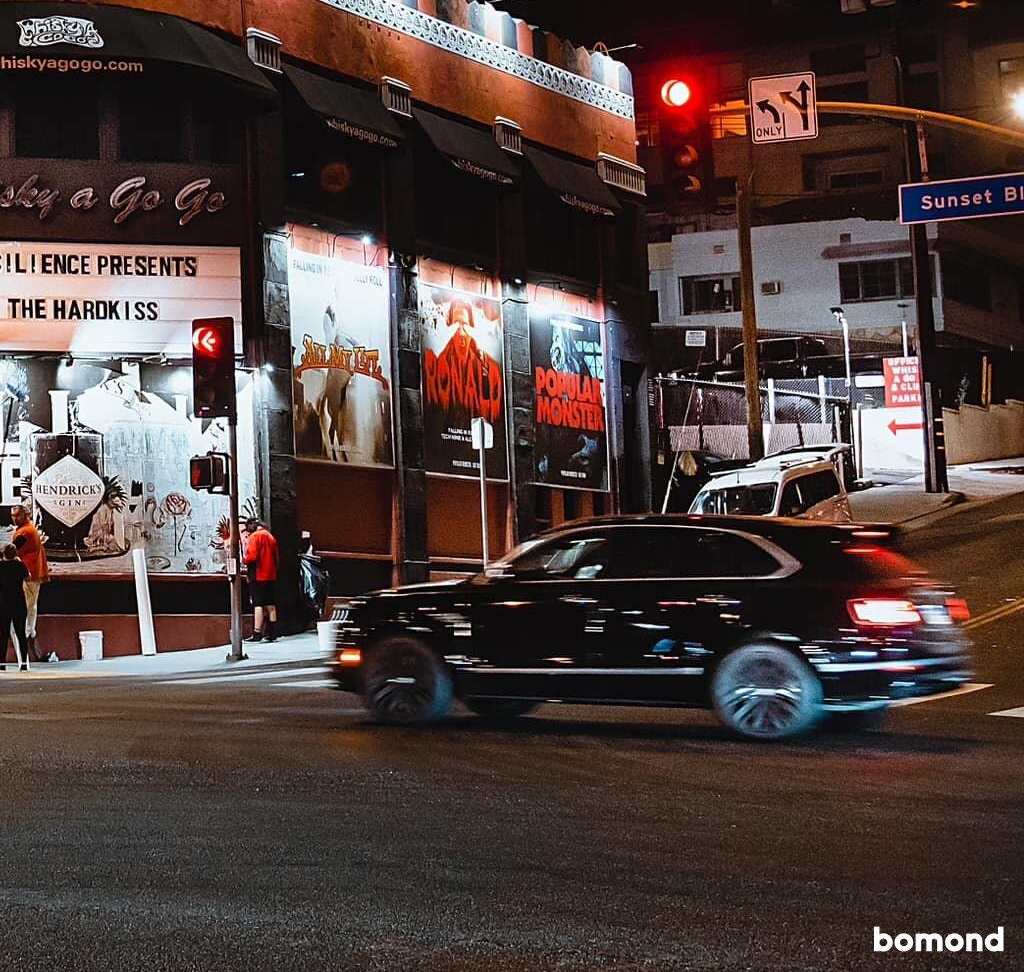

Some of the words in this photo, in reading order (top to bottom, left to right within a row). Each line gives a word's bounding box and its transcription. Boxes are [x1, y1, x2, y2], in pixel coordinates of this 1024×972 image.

[756, 126, 782, 138] ONLY
[70, 187, 99, 210] a
[109, 177, 163, 224] Go
[175, 178, 228, 225] Go
[921, 189, 993, 210] Sunset
[1004, 186, 1024, 202] Bl
[97, 255, 198, 277] PRESENTS
[8, 298, 46, 319] THE
[53, 299, 159, 321] HARDKISS
[892, 366, 918, 375] WHIS
[424, 348, 503, 422] RONALD
[535, 365, 603, 406] POPULAR
[891, 394, 922, 403] PARKI
[536, 395, 605, 432] MONSTER
[36, 484, 102, 495] HENDRICK'S
[58, 499, 81, 507] GIN
